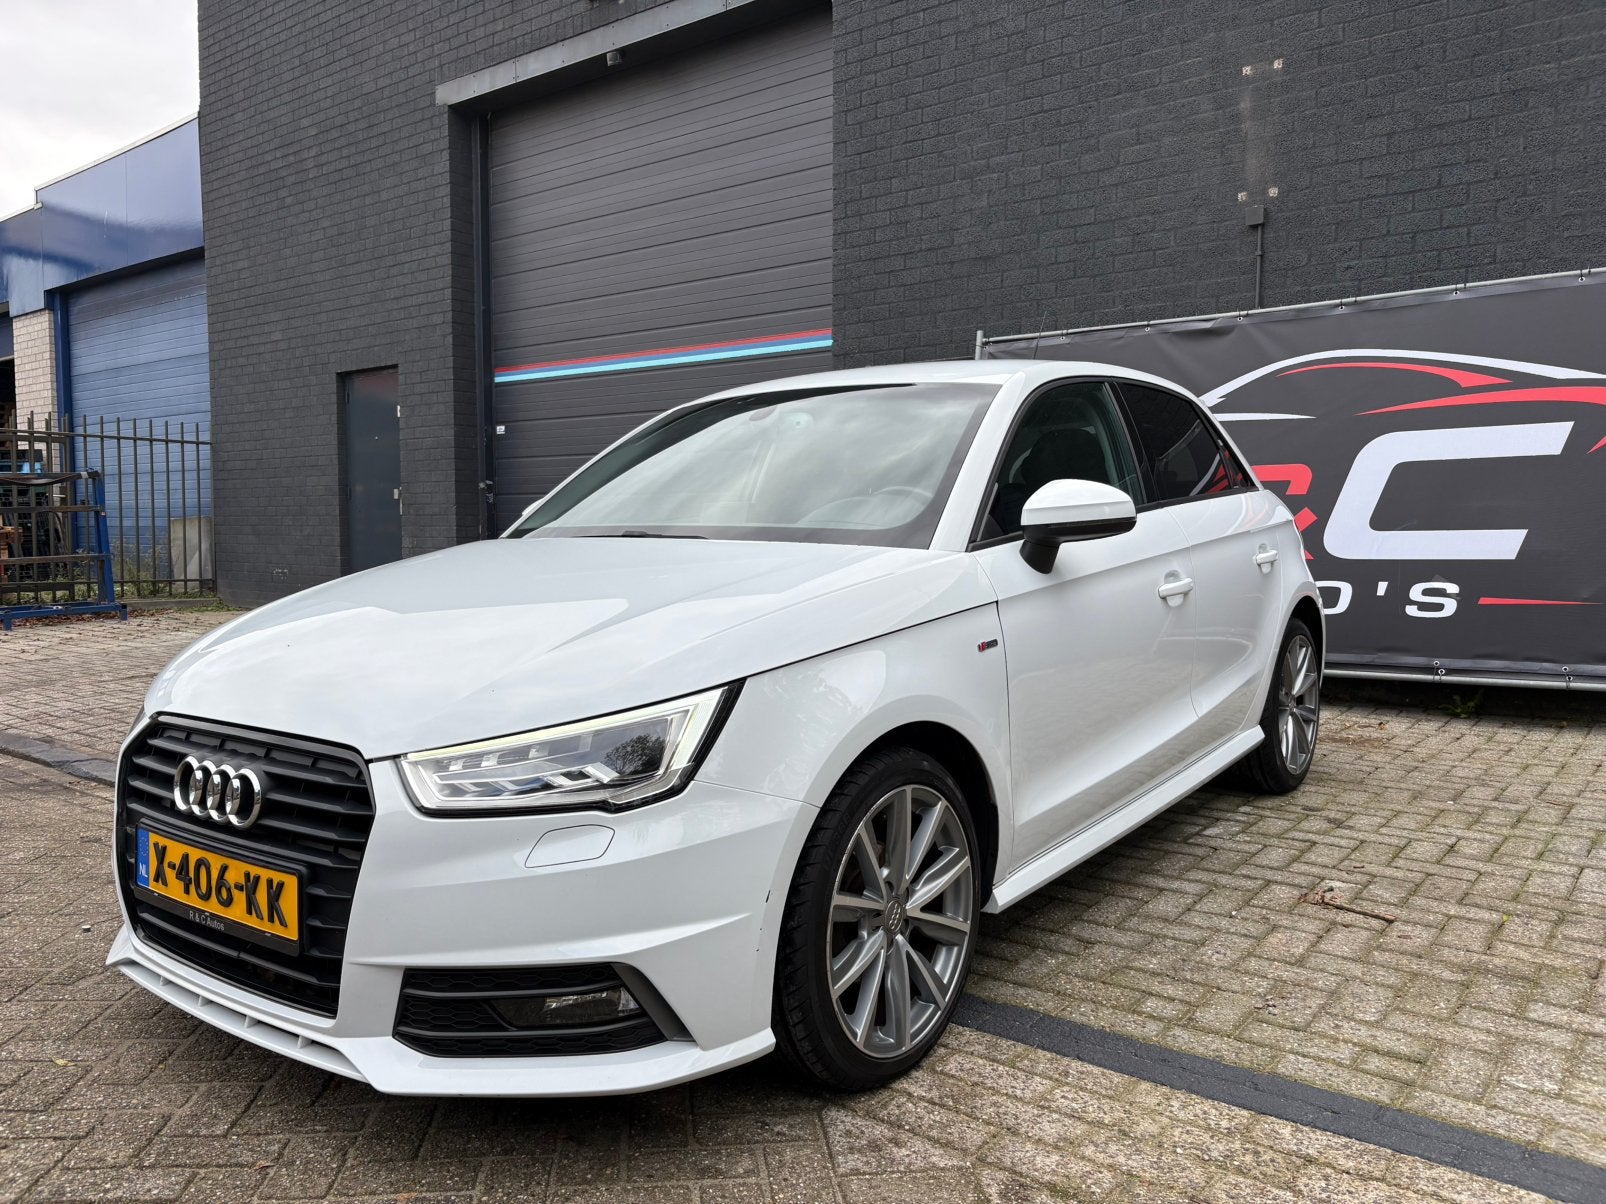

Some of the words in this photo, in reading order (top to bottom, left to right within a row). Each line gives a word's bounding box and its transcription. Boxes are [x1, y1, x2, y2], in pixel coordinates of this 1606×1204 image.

[139, 862, 148, 878] NL
[152, 841, 288, 928] X-406-KK
[206, 917, 225, 931] Autos
